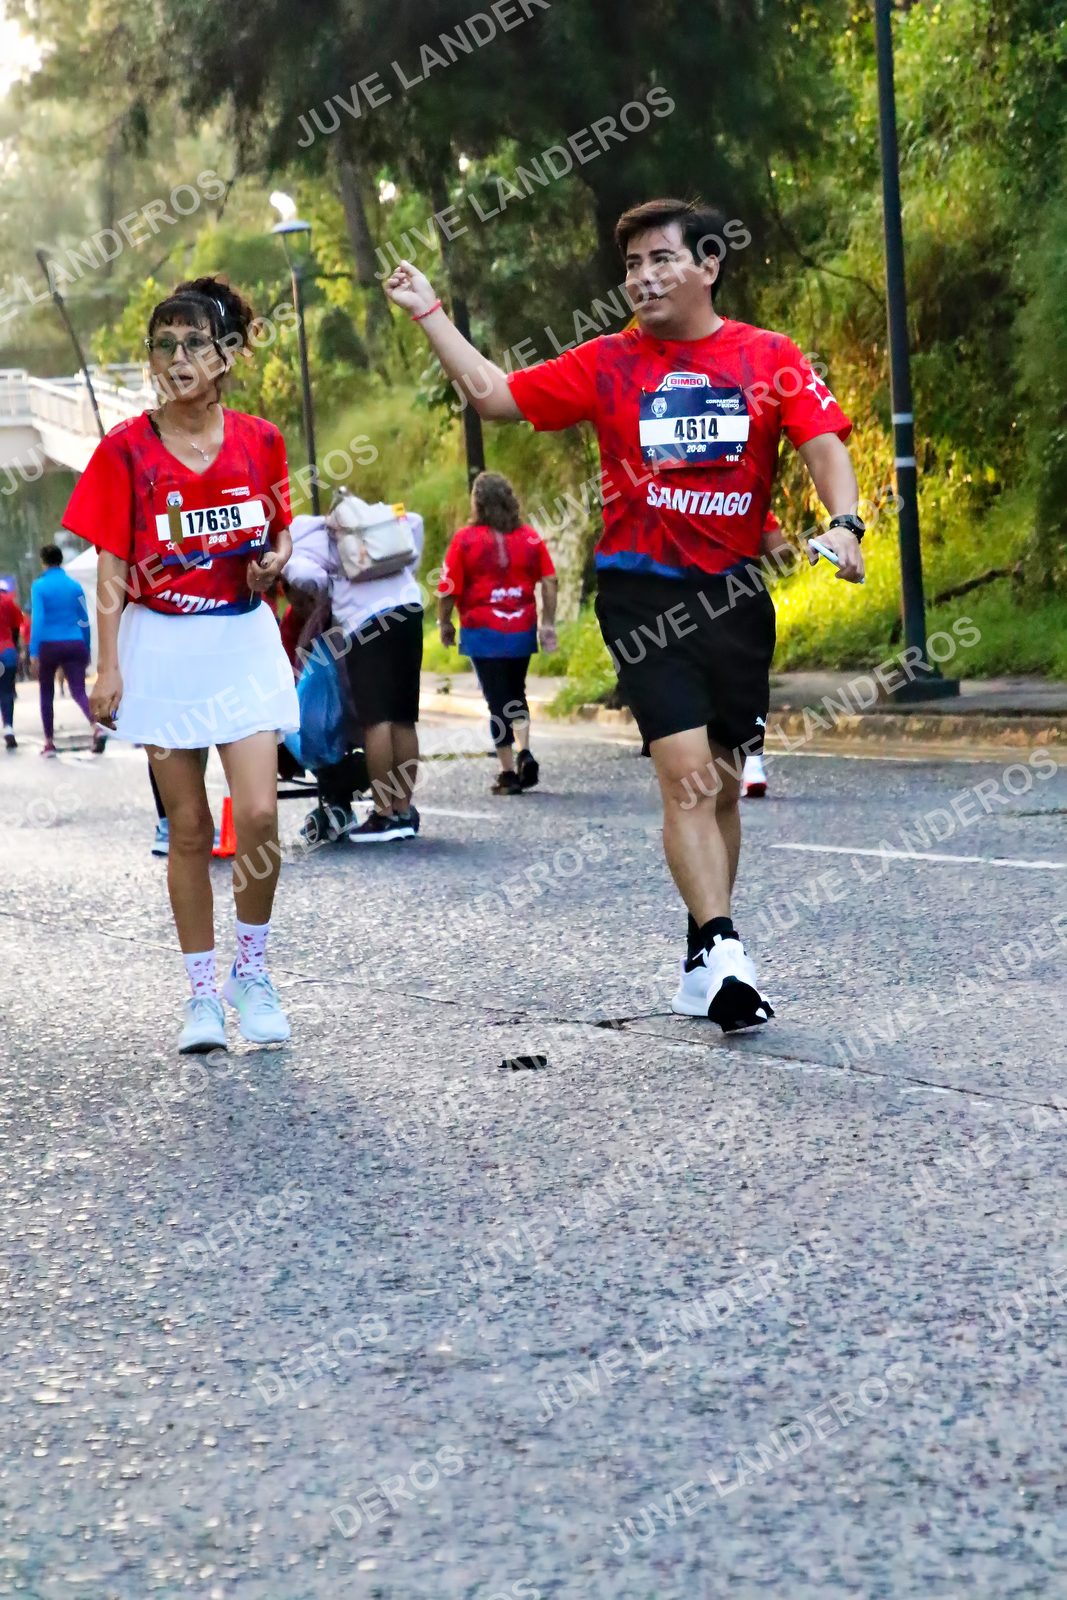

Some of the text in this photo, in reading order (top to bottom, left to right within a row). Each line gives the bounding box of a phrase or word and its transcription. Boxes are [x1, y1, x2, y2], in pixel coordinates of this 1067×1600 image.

[670, 378, 704, 386] BIMBO
[674, 418, 719, 441] 4614
[686, 444, 707, 453] 20-26
[646, 482, 752, 516] SANTIAGO
[186, 505, 242, 534] 17639
